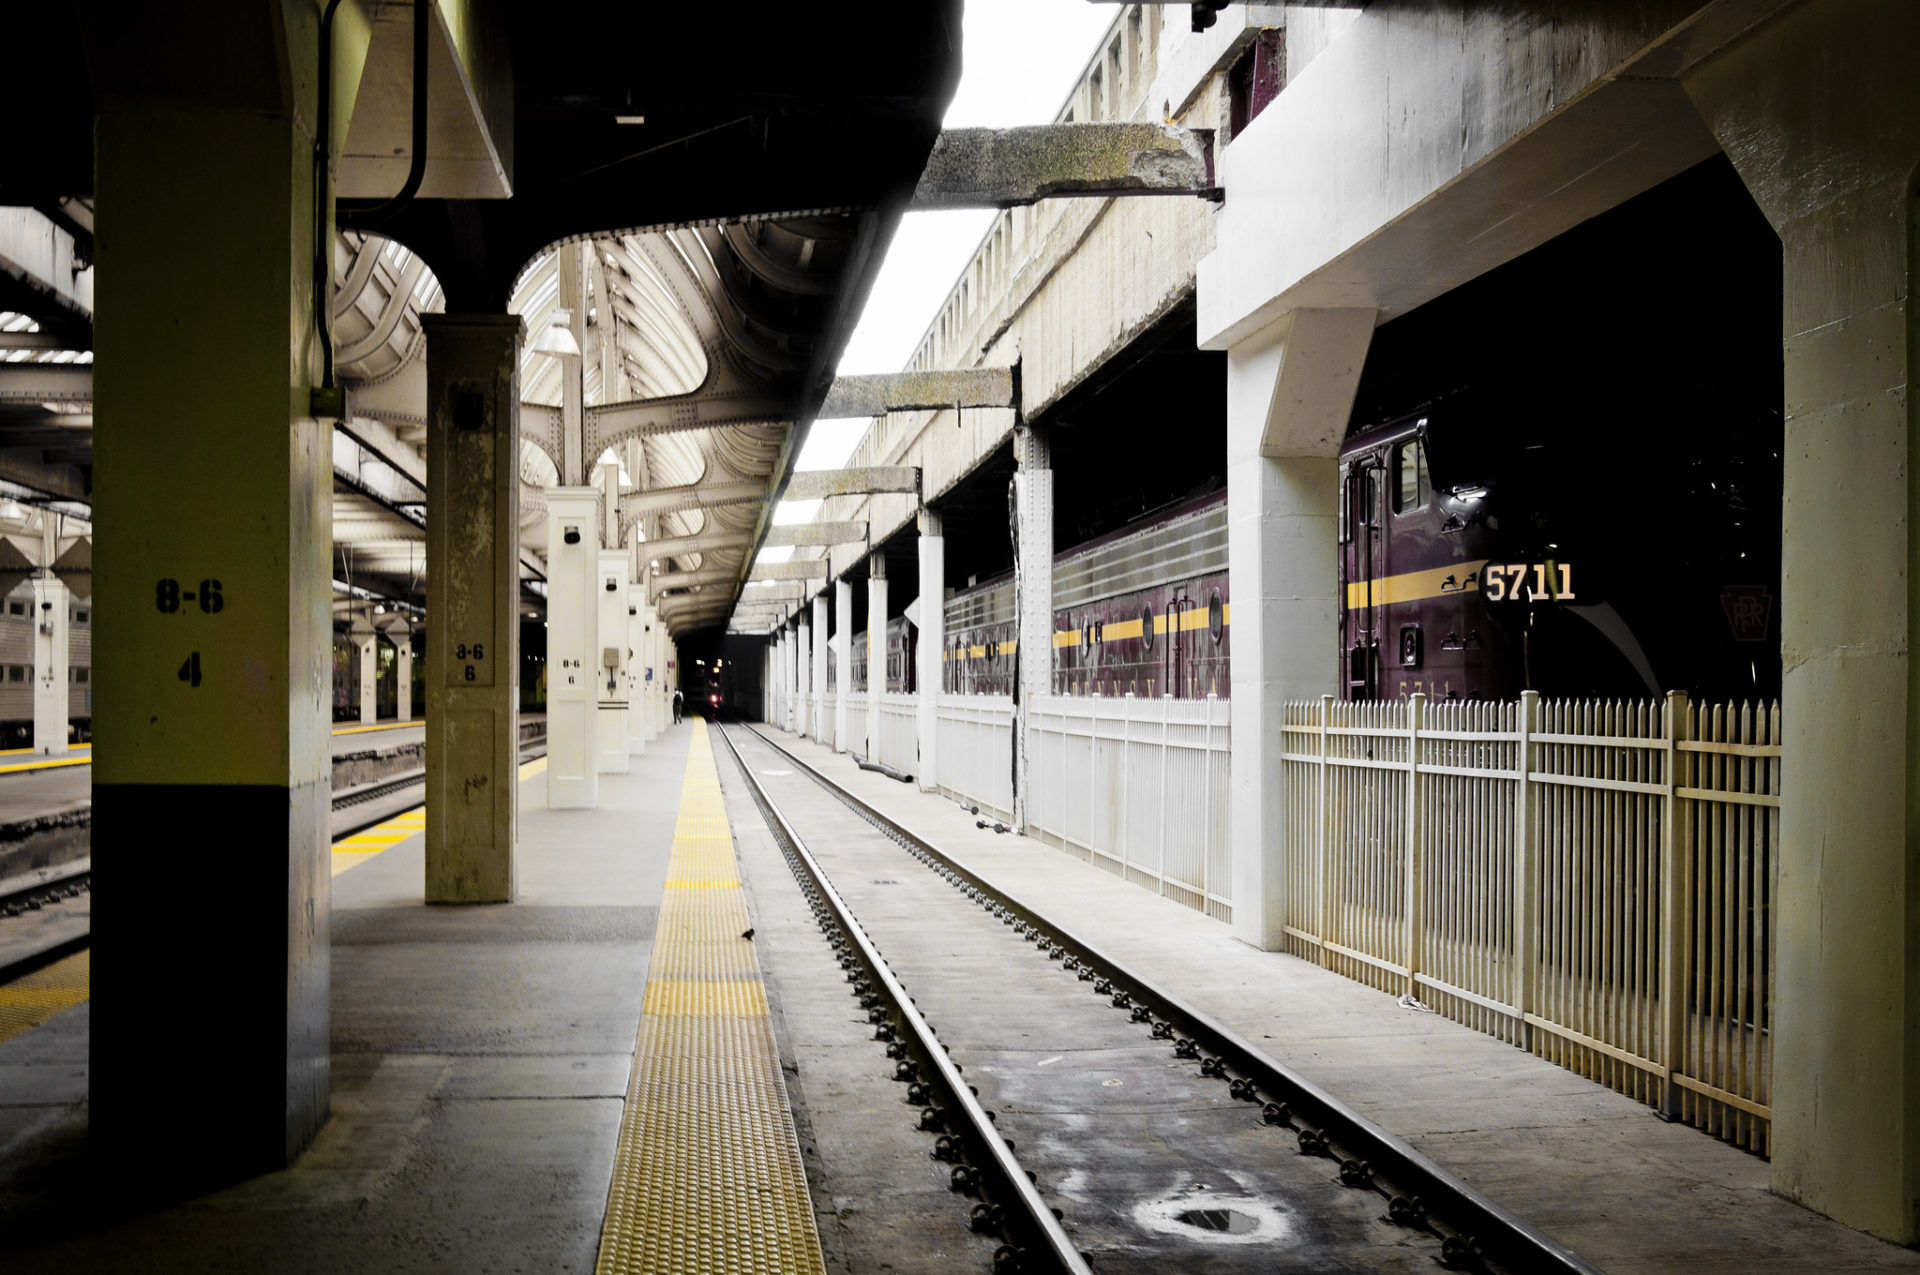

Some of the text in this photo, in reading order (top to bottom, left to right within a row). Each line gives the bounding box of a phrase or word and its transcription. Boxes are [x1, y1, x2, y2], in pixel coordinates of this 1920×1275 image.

[156, 578, 224, 614] 8-6
[1487, 563, 1575, 601] 5711
[178, 652, 202, 687] 4
[465, 665, 476, 681] 6
